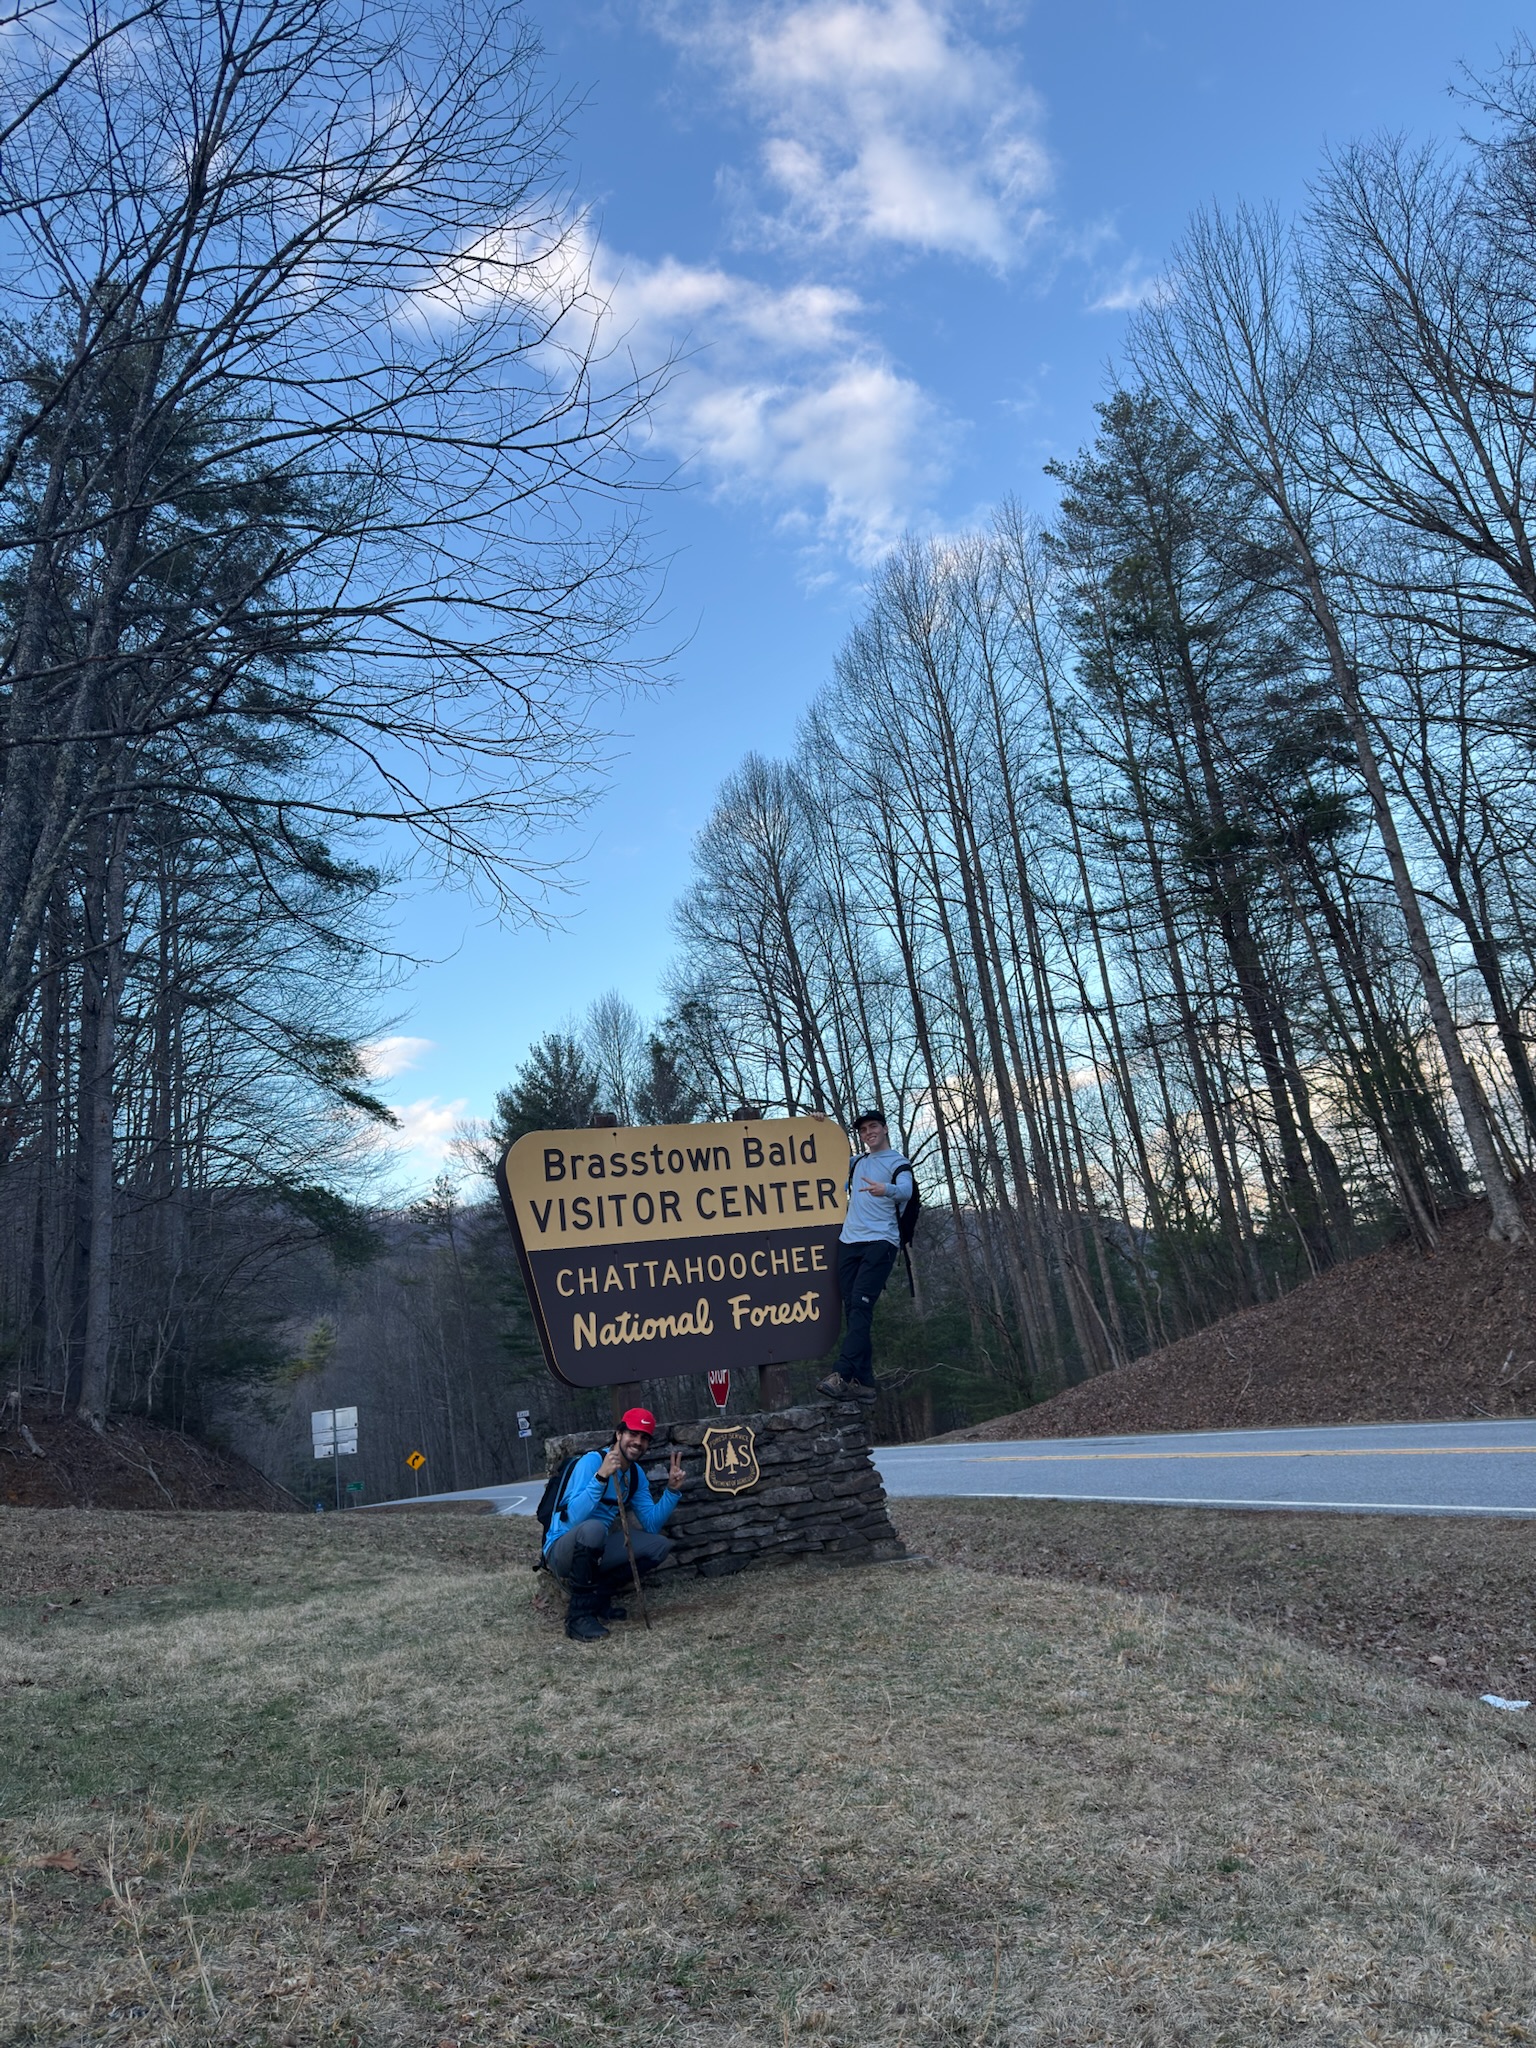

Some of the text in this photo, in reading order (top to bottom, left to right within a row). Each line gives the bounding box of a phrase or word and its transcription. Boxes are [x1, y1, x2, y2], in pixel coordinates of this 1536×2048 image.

[543, 1133, 817, 1182] Brasstown Bald
[530, 1178, 839, 1233] VISITOR CENTER
[556, 1245, 828, 1297] CHATTAHOOCHEE
[573, 1291, 820, 1351] National Forest
